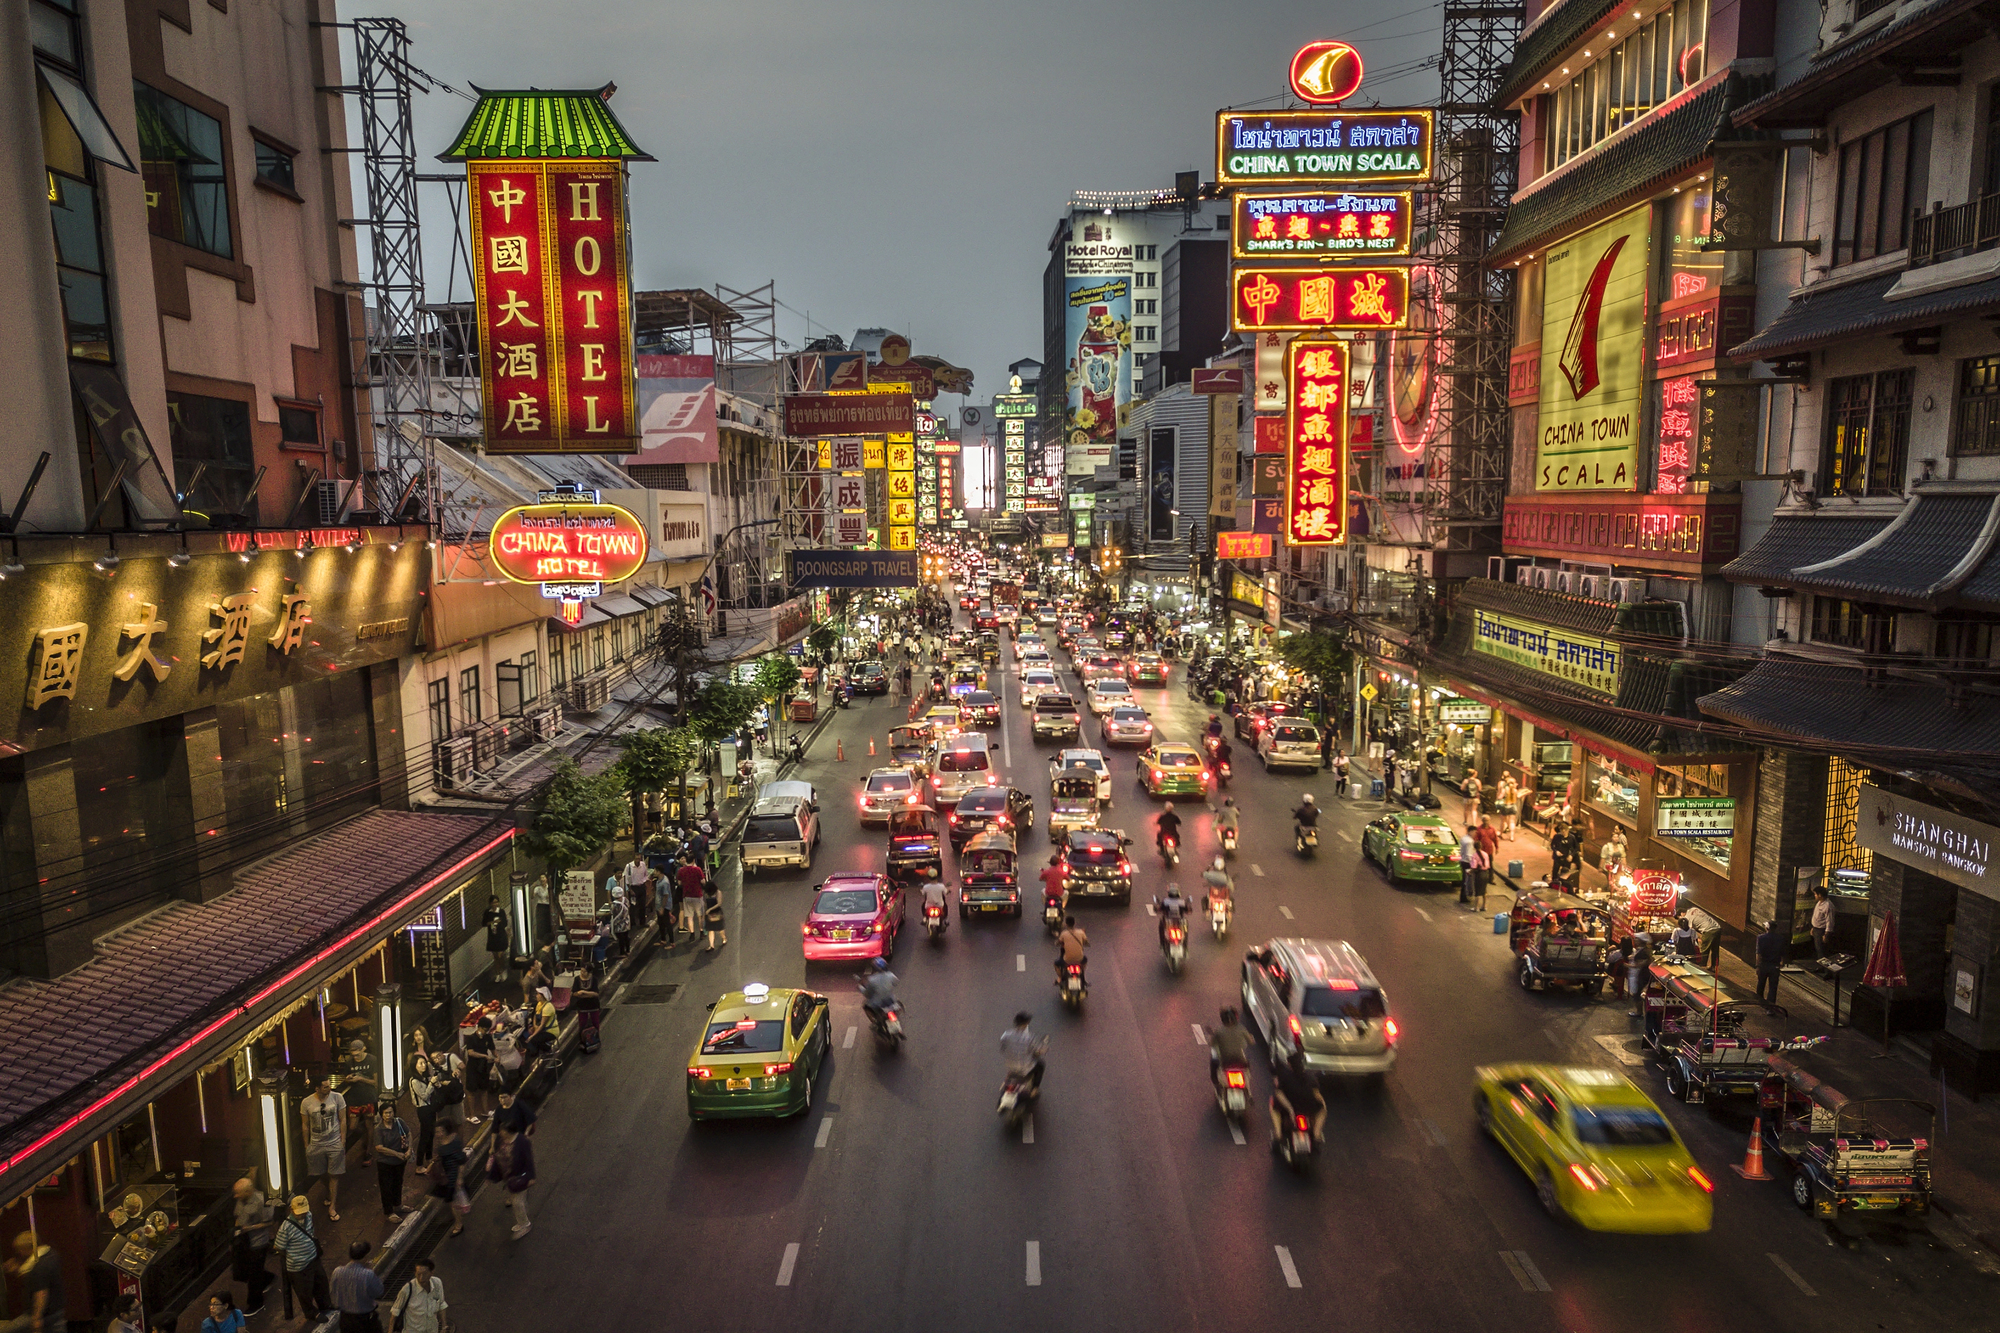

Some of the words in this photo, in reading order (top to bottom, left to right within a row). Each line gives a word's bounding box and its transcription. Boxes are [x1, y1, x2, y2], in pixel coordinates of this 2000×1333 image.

[1231, 118, 1342, 149] ไชน่าทาวน์
[1349, 118, 1420, 148] สกาล่า
[1229, 155, 1290, 174] CHINA
[1295, 154, 1352, 173] TOWN
[1357, 152, 1421, 172] SCALA
[1067, 244, 1099, 256] Hotel
[1100, 244, 1132, 259] Royal
[1247, 239, 1294, 251] SHARK'S
[1328, 238, 1365, 249] BIRD'S
[1367, 238, 1396, 249] NEST
[488, 179, 542, 434] 中國大酒店
[568, 182, 610, 434] HOTEL
[1103, 290, 1115, 301] 10
[1243, 273, 1393, 326] 中國城
[789, 396, 910, 432] รุ่งทรัพย์การท่องเที่ยว
[1543, 420, 1584, 447] CHINA
[1591, 413, 1630, 442] TOWN
[1293, 349, 1343, 539] 銀都魚翅酒樓
[1541, 461, 1627, 488] SCALA
[500, 531, 568, 554] CHINA
[577, 531, 638, 556] TOWN
[796, 560, 868, 577] ROONGSARP
[872, 560, 914, 577] TRAVEL
[1477, 611, 1550, 656] ไชน่าทาวน์
[1515, 650, 1538, 669] SCALA
[1894, 811, 1989, 862] SHANGHAI
[1892, 832, 1936, 860] MANSION
[1941, 850, 1987, 878] BANGKOK
